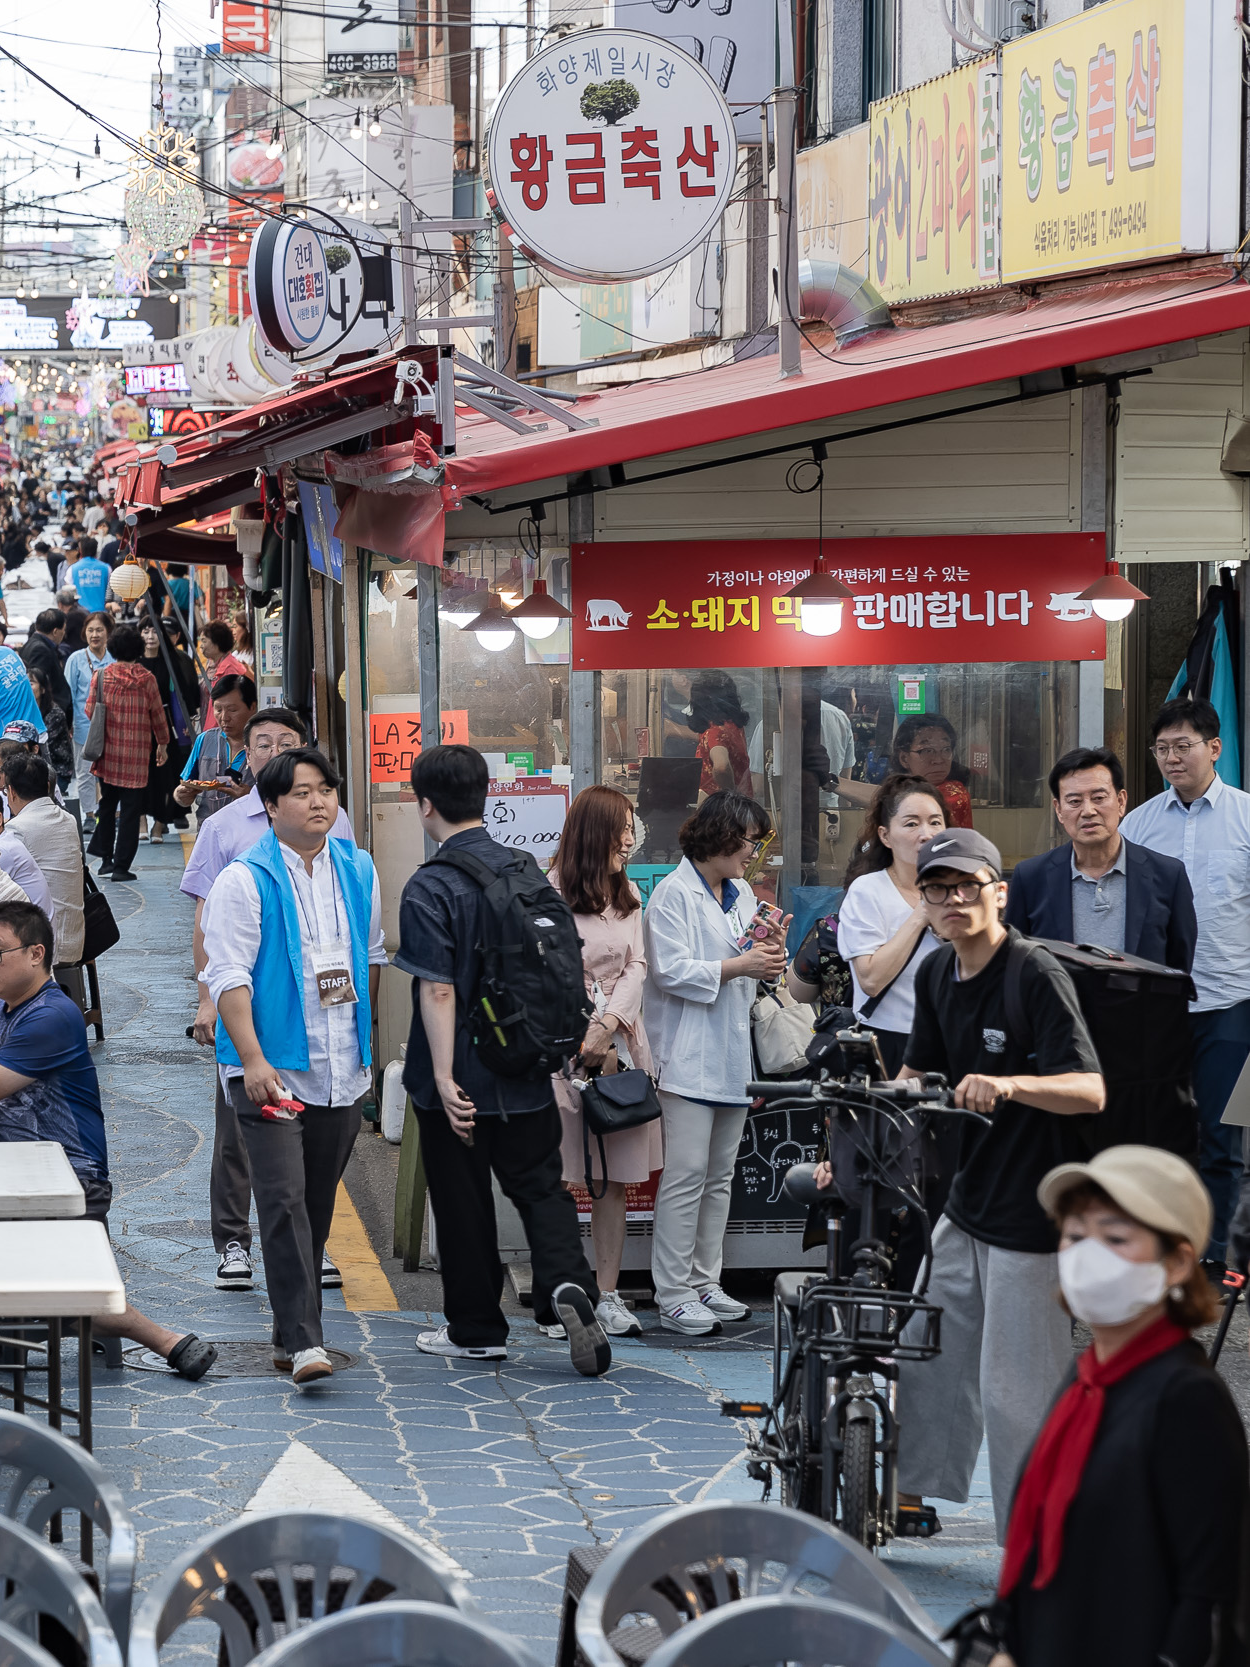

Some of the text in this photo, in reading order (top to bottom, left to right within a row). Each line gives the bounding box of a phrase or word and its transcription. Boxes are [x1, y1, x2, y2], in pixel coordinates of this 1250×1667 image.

[536, 47, 677, 97] 화양제일시장
[1018, 24, 1161, 202] 황금축산
[510, 125, 720, 211] 황금축산
[871, 82, 976, 287] 광어2마리
[981, 80, 998, 272] 초밥
[294, 241, 314, 270] 건대
[287, 271, 324, 303] 대호횟집
[707, 570, 764, 587] 가정이나
[890, 566, 918, 583] 드실
[922, 568, 938, 582] 수
[941, 566, 971, 583] 있는
[852, 589, 1034, 630] 판매합니다
[373, 722, 400, 745] LA
[320, 976, 347, 990] STAFF
